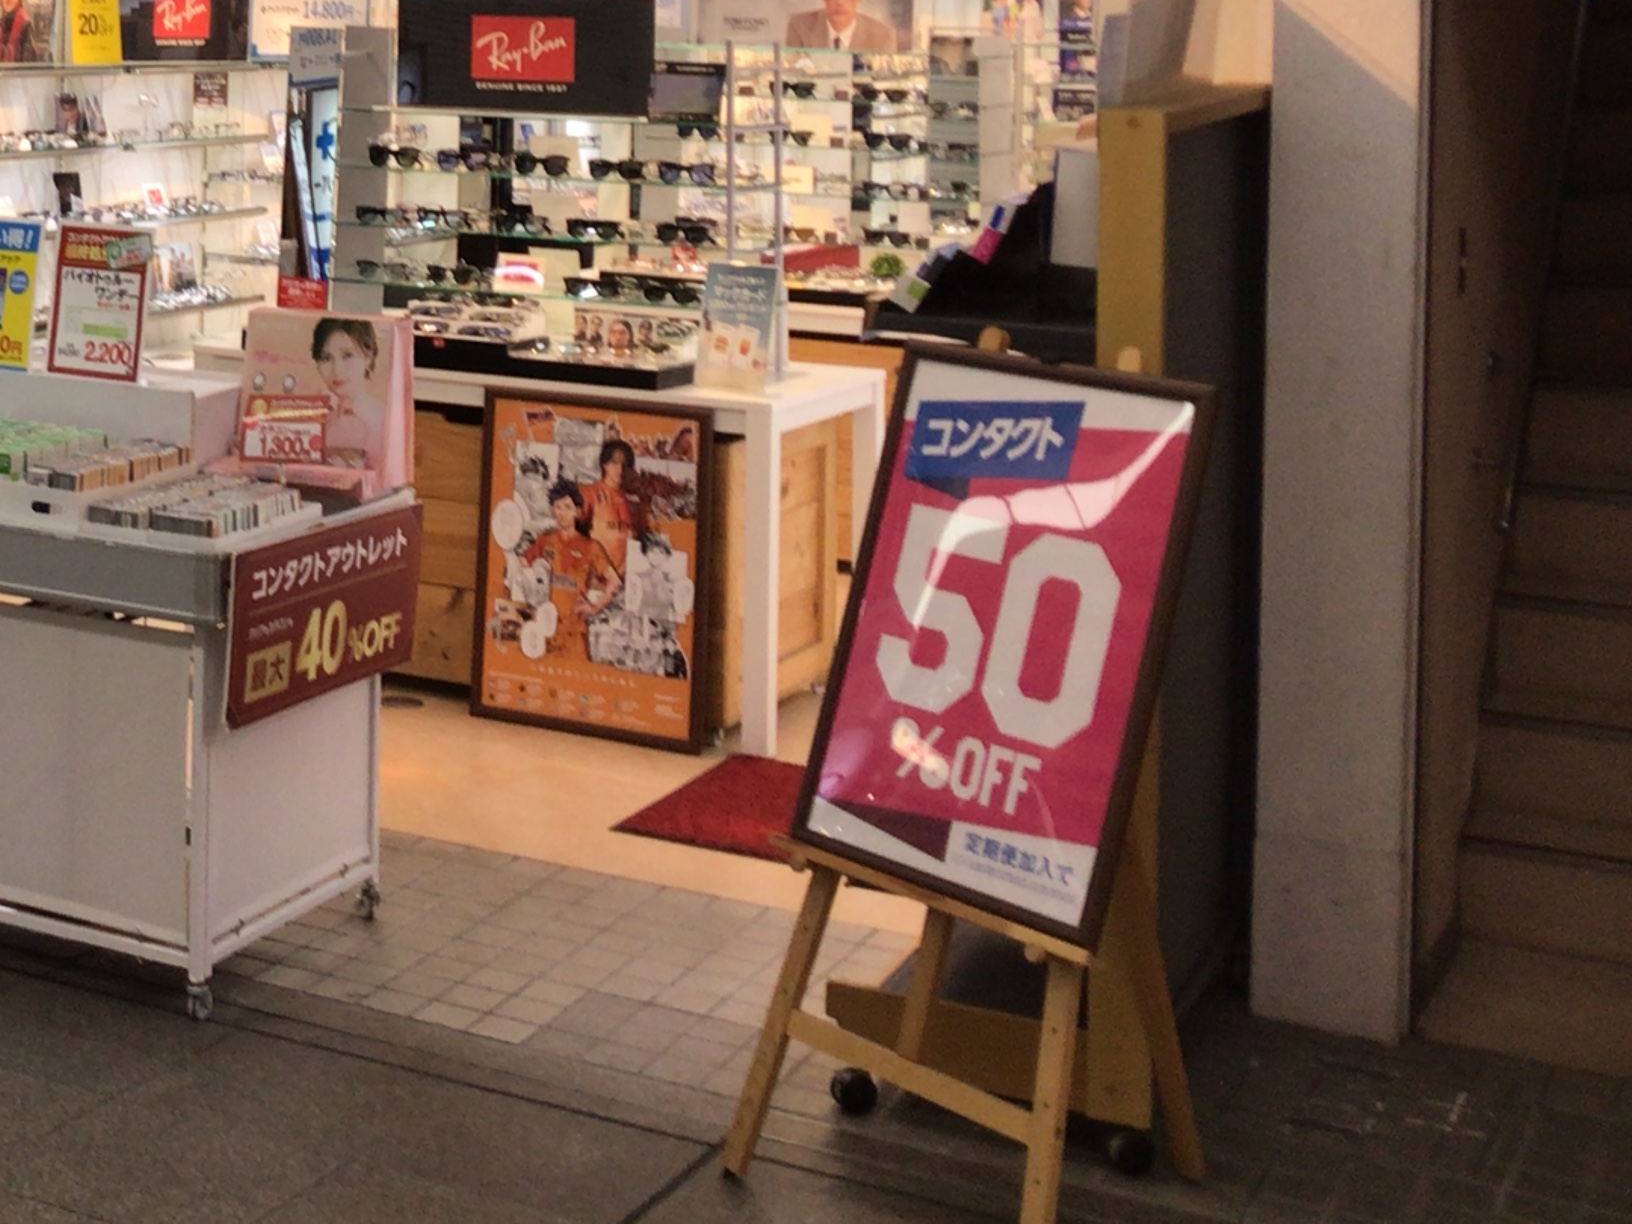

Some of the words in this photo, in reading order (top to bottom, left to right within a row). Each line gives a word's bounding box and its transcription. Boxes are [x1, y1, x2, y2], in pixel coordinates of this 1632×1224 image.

[476, 20, 567, 73] Ray-Ban
[920, 416, 1065, 463] コンタクト
[252, 526, 408, 601] コンタクトアウトレット
[876, 504, 1121, 749] 50
